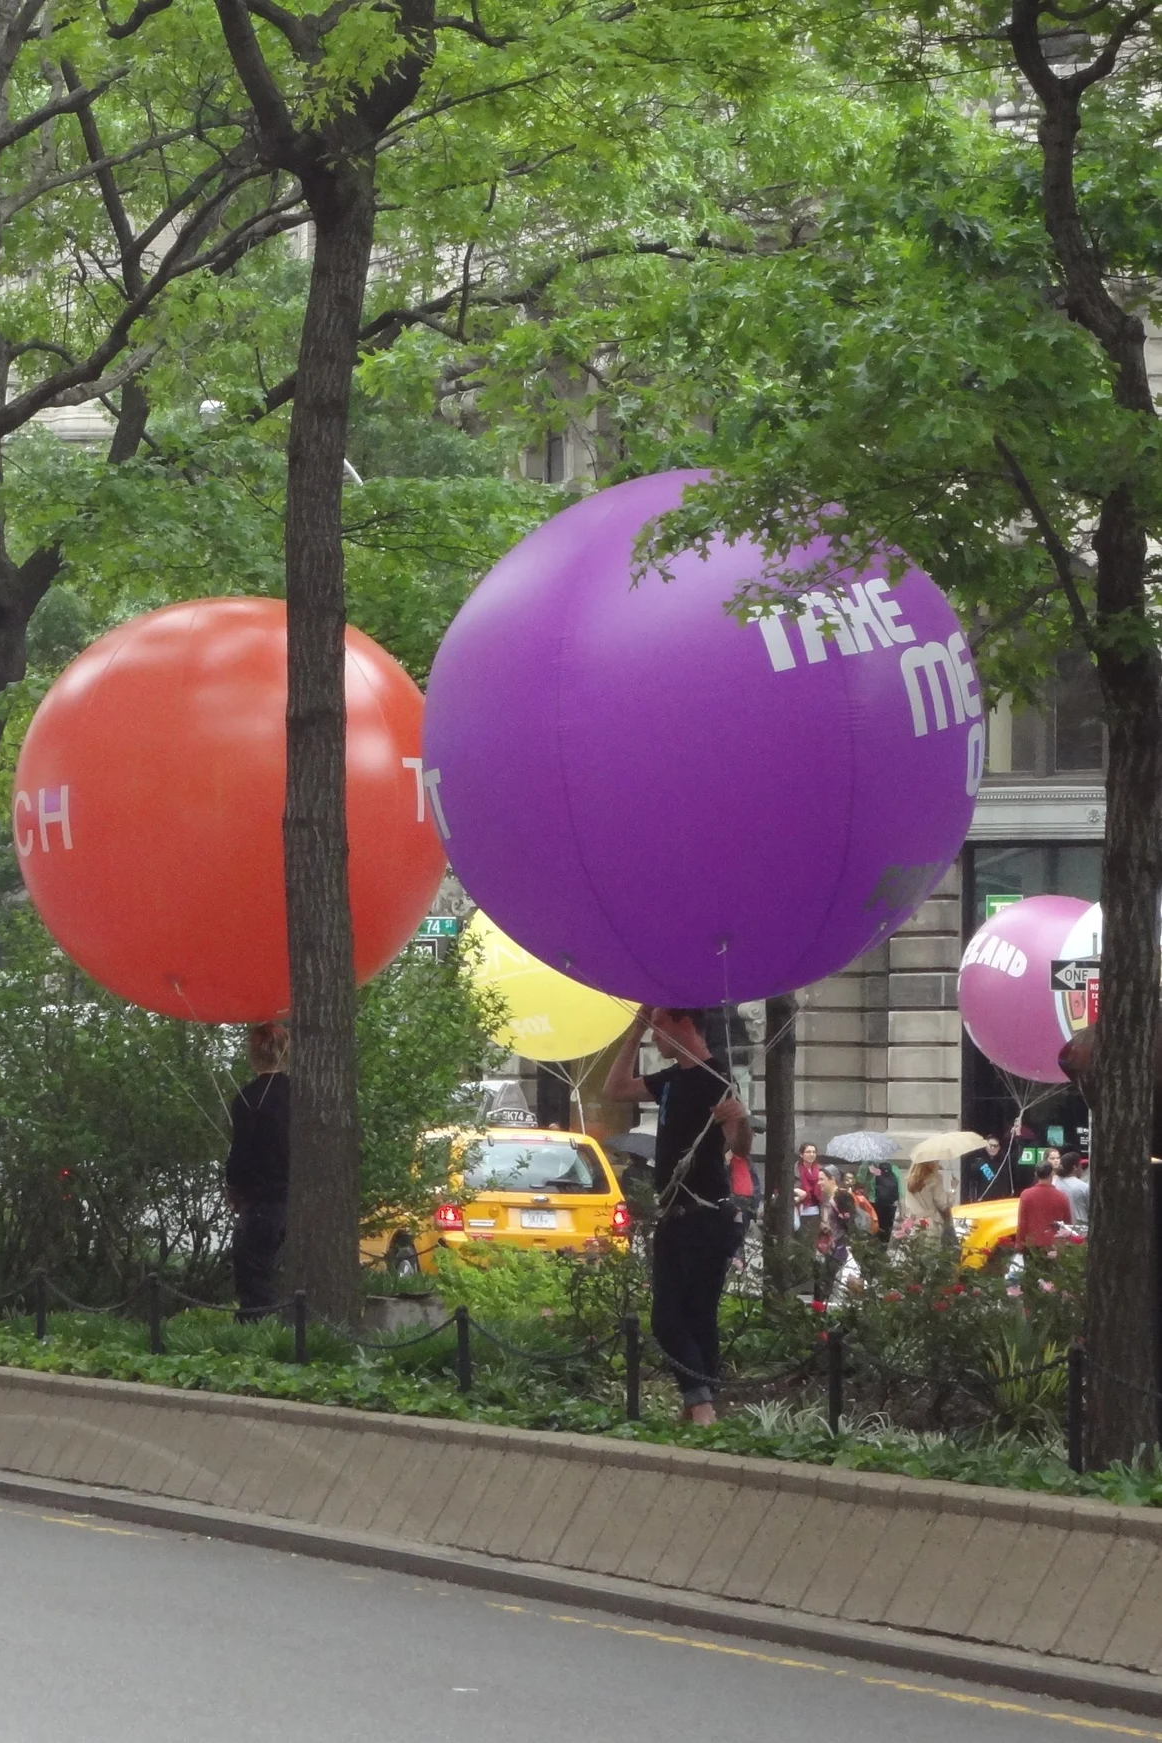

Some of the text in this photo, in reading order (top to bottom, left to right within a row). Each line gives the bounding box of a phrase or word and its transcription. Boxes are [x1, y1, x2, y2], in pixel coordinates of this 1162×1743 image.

[746, 577, 917, 673] TAKE
[900, 631, 982, 738] ME
[14, 784, 74, 857] CH
[426, 919, 454, 934] 74 ST
[1064, 969, 1089, 982] ONE
